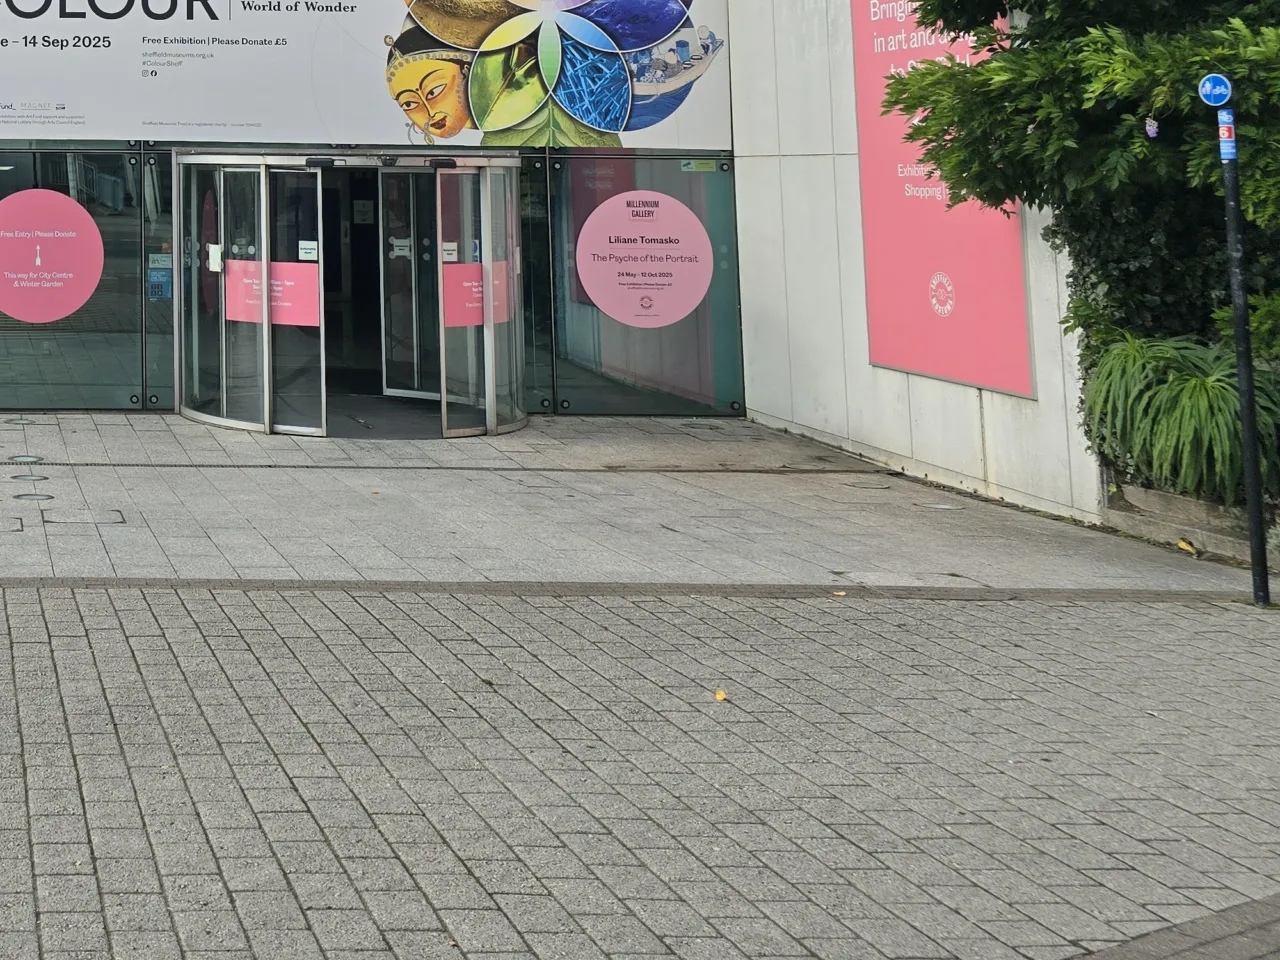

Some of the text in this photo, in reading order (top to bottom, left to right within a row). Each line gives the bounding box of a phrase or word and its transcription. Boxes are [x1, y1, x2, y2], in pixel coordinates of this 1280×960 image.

[241, 0, 357, 13] World of Wonder
[22, 36, 38, 48] 14
[42, 36, 69, 51] Sep
[72, 36, 111, 49] 2025
[142, 36, 162, 44] Free
[163, 36, 206, 45] Exhibition
[211, 37, 240, 46] Please
[241, 37, 273, 46] Donate
[274, 38, 288, 46] £5
[874, 32, 885, 53] in
[888, 29, 908, 51] art
[904, 183, 942, 199] Shopping
[626, 200, 660, 208] MILLENNIUM
[631, 209, 655, 218] GALLERY
[15, 230, 31, 238] Entry
[34, 230, 54, 238] Please
[55, 230, 77, 238] Donate
[608, 236, 680, 245] Liliane Tomasko
[591, 253, 699, 264] The Psyche of the Portrait
[29, 271, 38, 279] for
[38, 272, 52, 280] City
[625, 271, 637, 279] May
